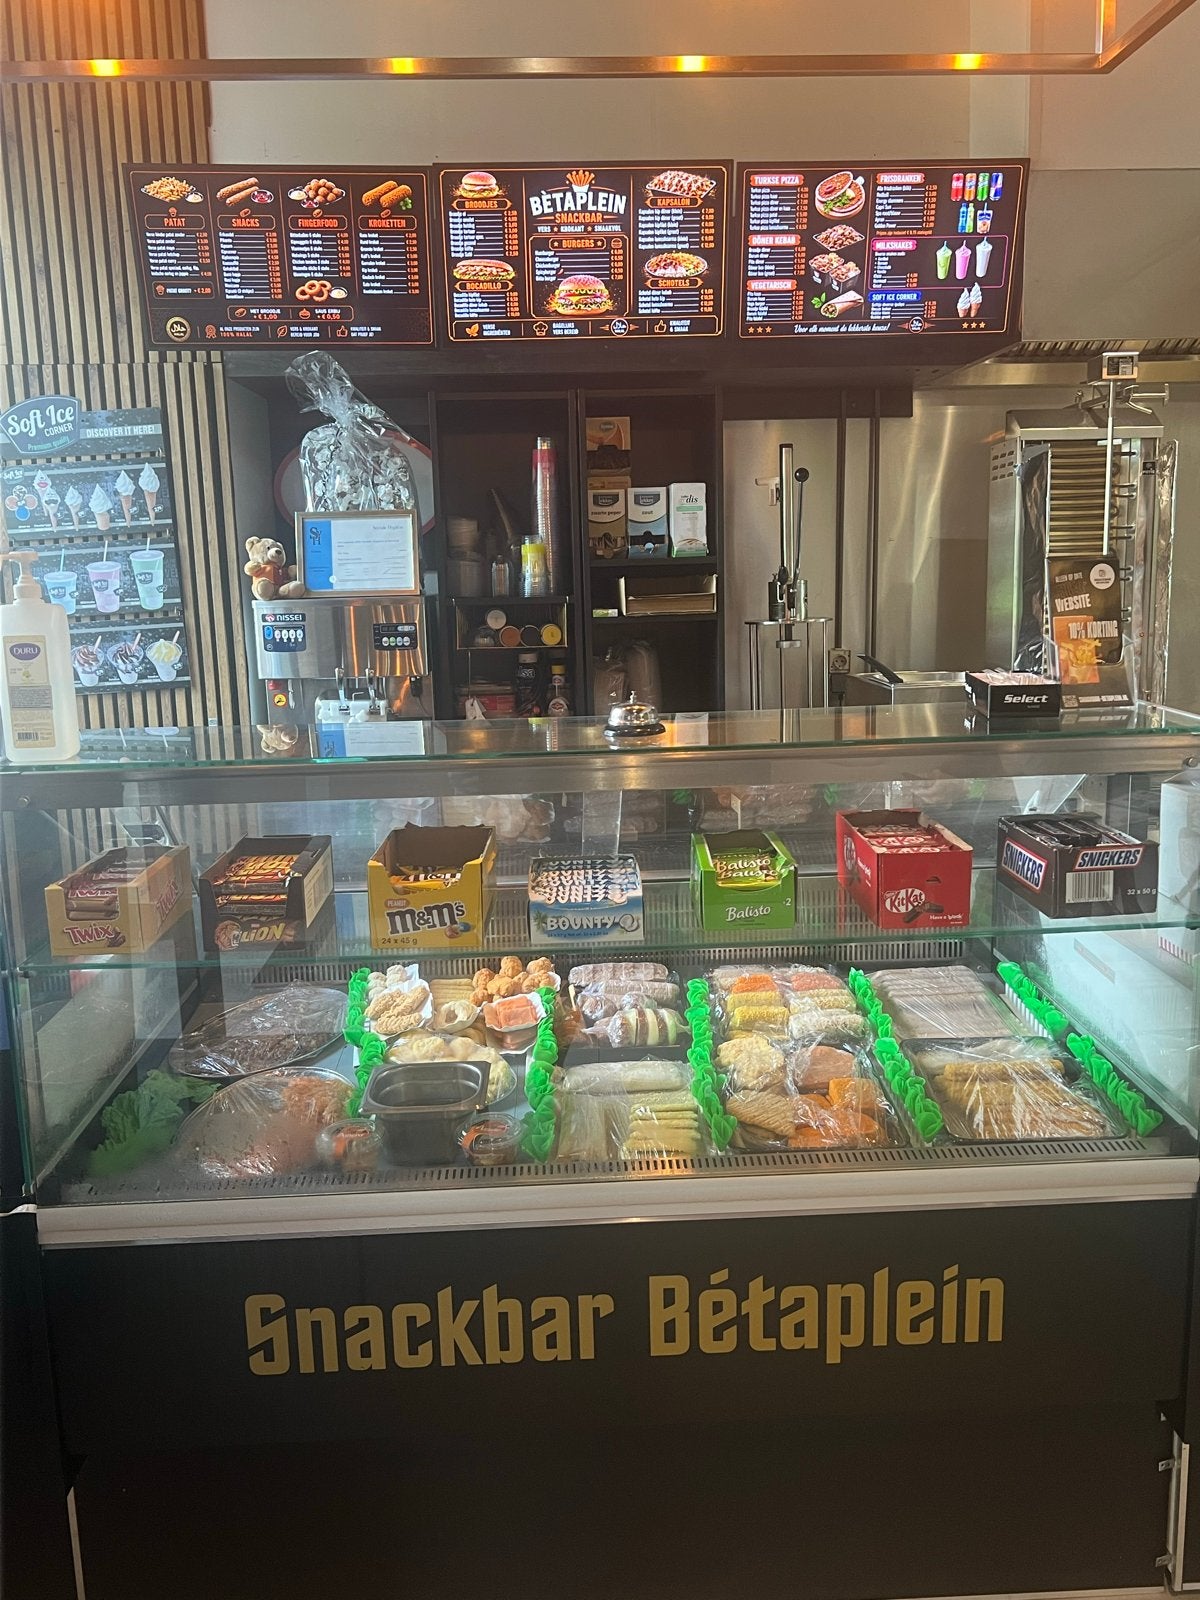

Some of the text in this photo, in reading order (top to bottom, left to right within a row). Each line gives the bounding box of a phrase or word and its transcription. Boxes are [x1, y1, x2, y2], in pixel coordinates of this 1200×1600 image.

[754, 176, 799, 184] TURKSE PIZZA
[529, 190, 627, 216] BÈTAPLEIN
[657, 198, 690, 206] KAPSALON
[164, 218, 186, 227] PATAT
[232, 218, 260, 227] SNACKS
[298, 219, 338, 228] FINGERFOOD
[368, 219, 406, 228] KROKETTEN
[555, 212, 603, 224] SNACKBAR
[562, 240, 594, 248] BURGERS
[752, 236, 796, 244] DÖNER KEBAB
[466, 282, 502, 290] BOCADILLO
[7, 405, 75, 437] Soft Ice
[44, 423, 74, 437] CORNER
[86, 424, 155, 438] DISCOVER IT HERE!
[1055, 594, 1092, 612] WEBSITE
[1068, 620, 1118, 639] 10% KORTING
[1004, 694, 1048, 704] Select
[716, 858, 771, 873] Balisto
[1003, 842, 1044, 888] SNICKERS
[1078, 850, 1140, 868] SNICKERS
[889, 888, 922, 912] KitKat
[726, 905, 771, 922] Balisto
[547, 916, 616, 931] BOUNTY
[244, 1264, 1005, 1376] Snackbar Bétaplein
